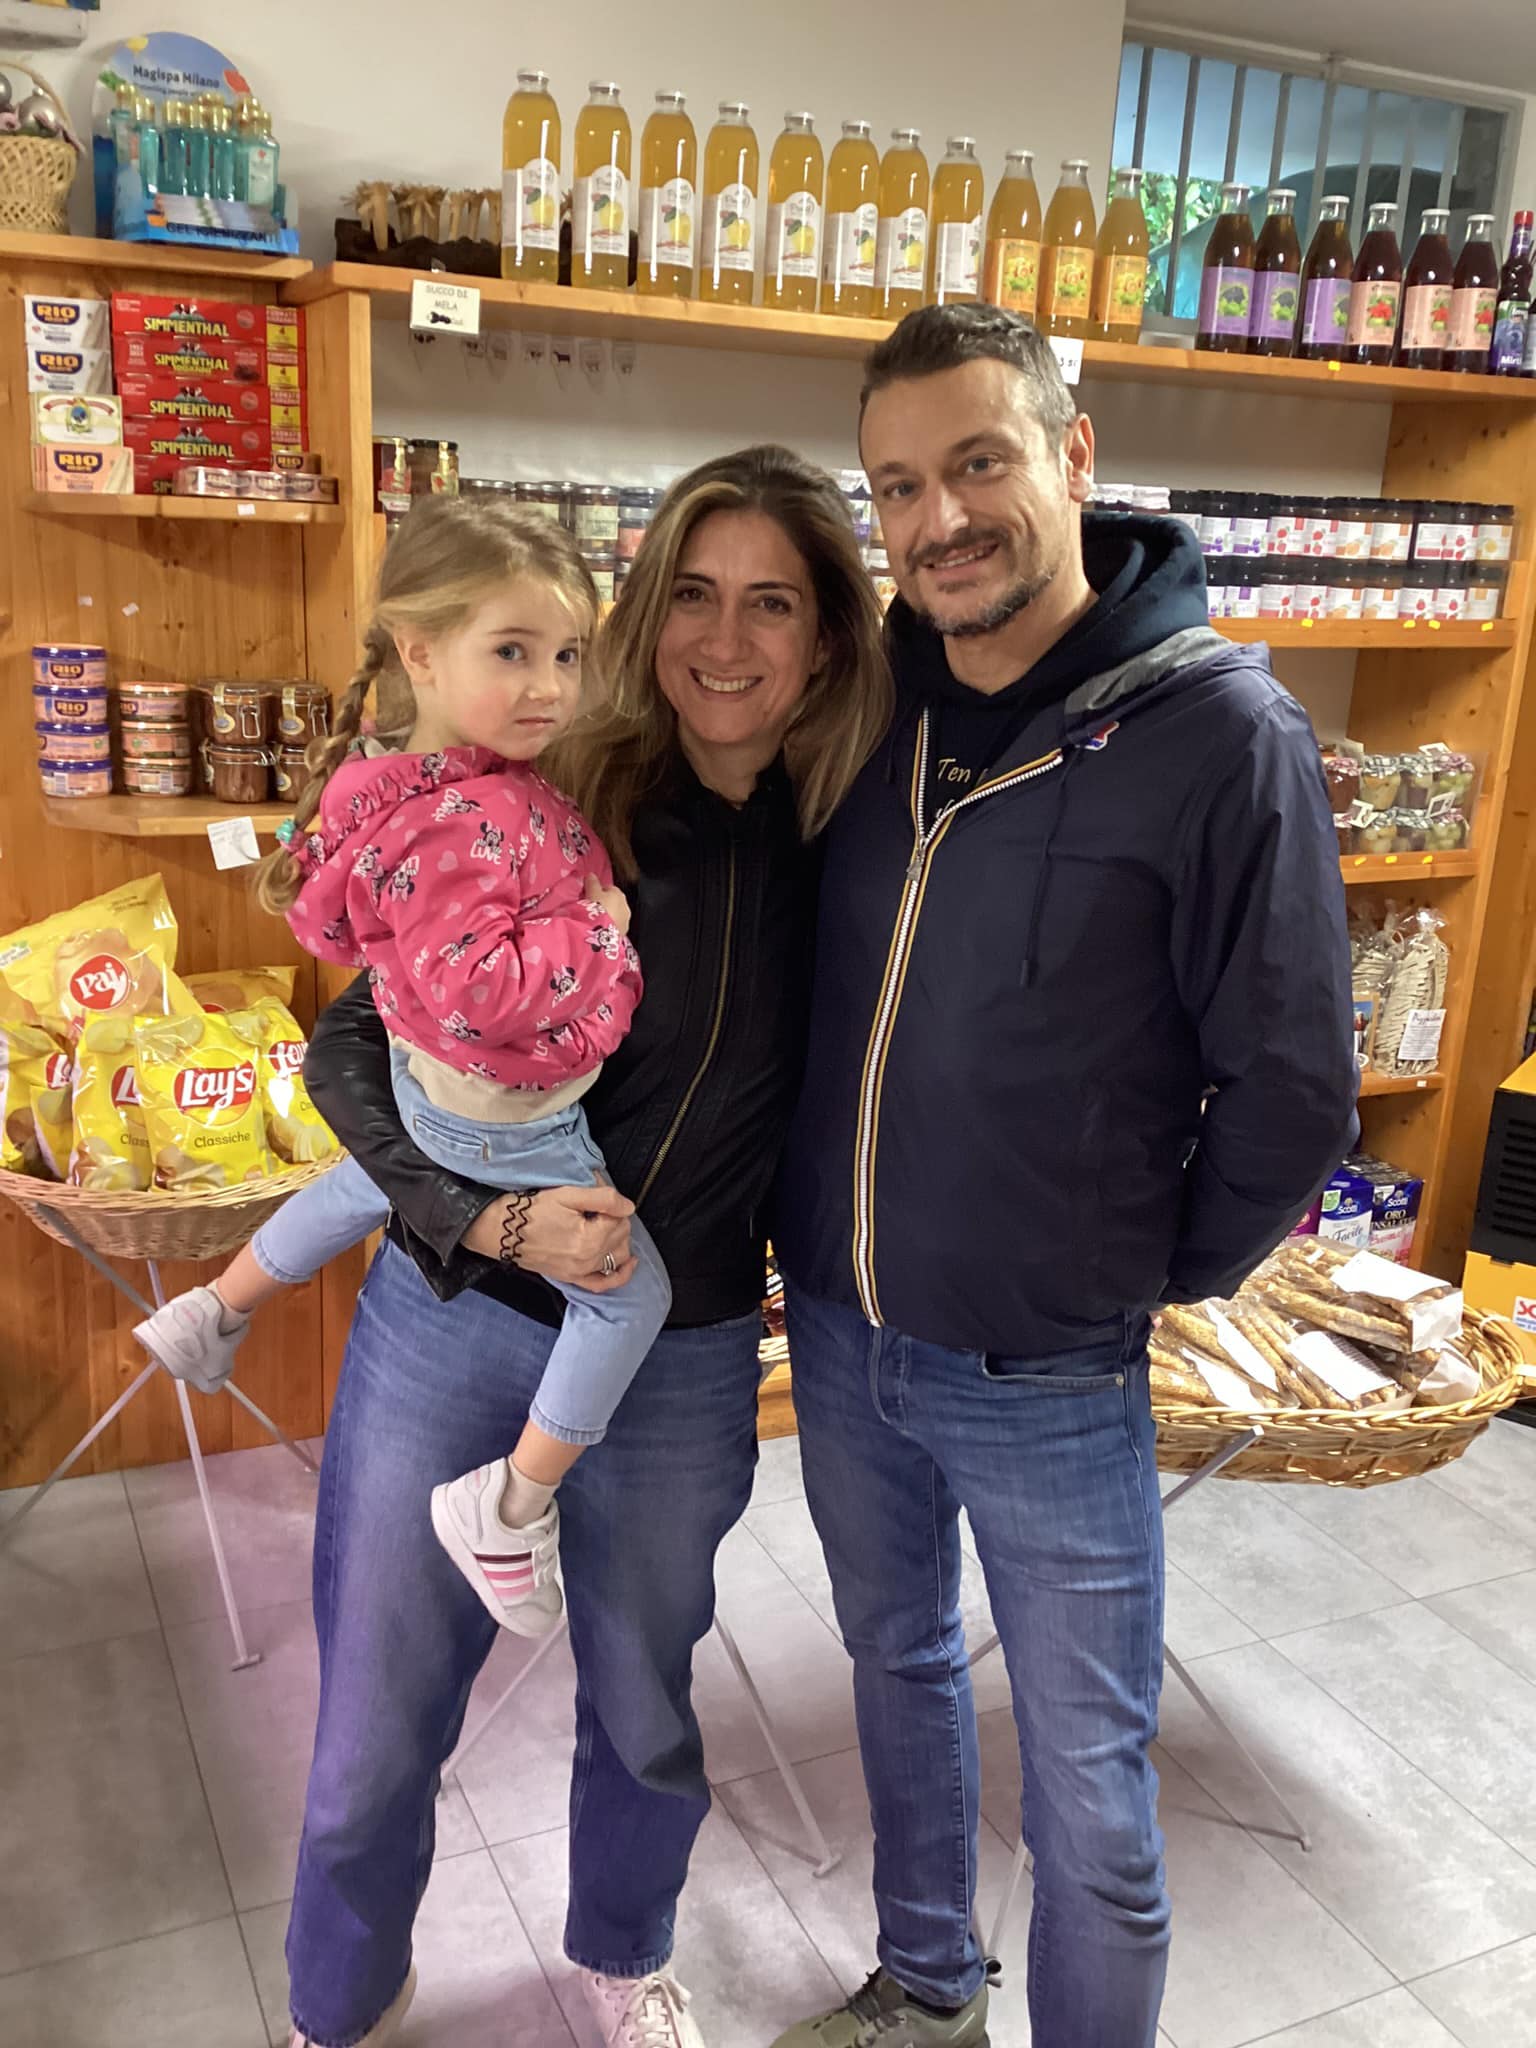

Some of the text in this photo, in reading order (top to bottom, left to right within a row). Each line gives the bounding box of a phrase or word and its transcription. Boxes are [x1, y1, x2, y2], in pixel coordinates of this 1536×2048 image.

[133, 65, 180, 83] Magispa
[182, 72, 220, 89] Milano
[426, 285, 455, 297] SUCCO
[36, 304, 76, 319] RIO
[435, 300, 458, 311] MELA
[143, 317, 230, 337] SIMMENTHAL
[40, 354, 79, 368] RIO
[154, 353, 230, 371] SIMMENTHAL
[150, 400, 234, 419] SIMMENTHAL
[151, 440, 235, 458] SIMMENTHAL
[58, 453, 99, 467] RIO
[52, 664, 82, 674] RIO
[56, 701, 85, 711] RIO
[938, 758, 971, 783] Ten
[181, 1063, 254, 1112] Lay's
[194, 1131, 251, 1149] Classiche
[1385, 1210, 1407, 1220] ORO
